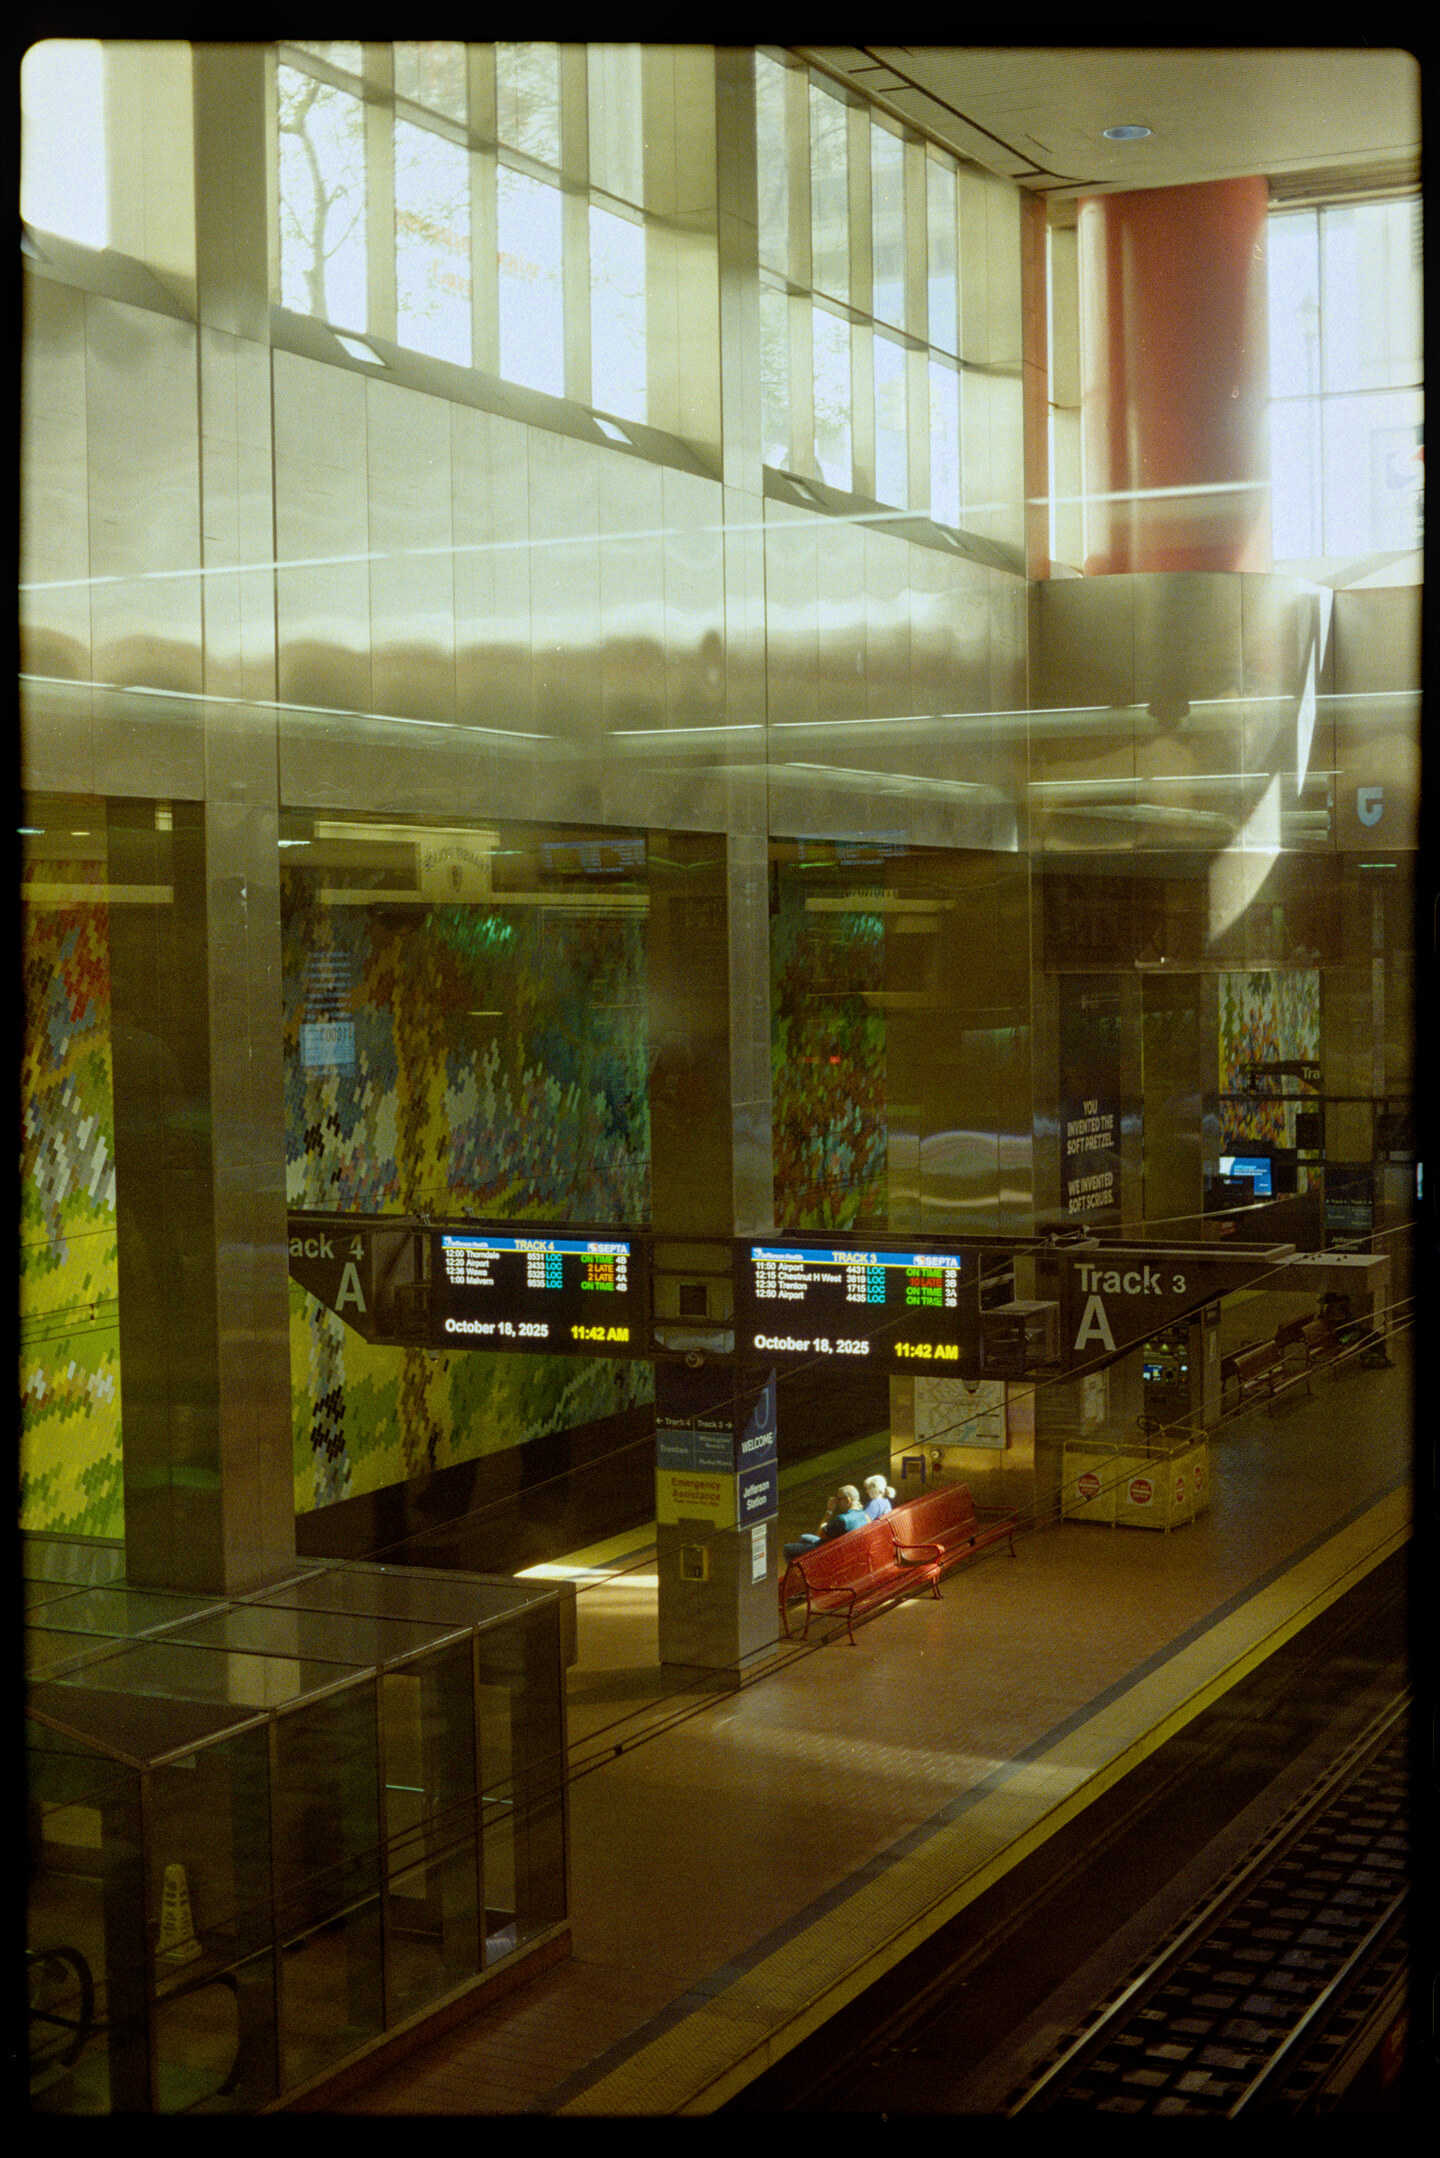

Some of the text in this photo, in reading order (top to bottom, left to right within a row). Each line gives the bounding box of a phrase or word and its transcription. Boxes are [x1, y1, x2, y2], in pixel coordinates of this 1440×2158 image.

[1301, 1066, 1320, 1080] Tra
[1083, 1100, 1098, 1115] YOU
[1067, 1113, 1114, 1137] INVENTED THE
[1067, 1137, 1085, 1155] SOFT
[1068, 1171, 1114, 1197] WE INVENTED
[1068, 1195, 1086, 1214] SOFT
[289, 1232, 365, 1261] ack 4
[514, 1240, 554, 1251] TRACK 4
[598, 1244, 628, 1253] SEPTA
[446, 1250, 464, 1258] 12:00
[466, 1250, 500, 1260] Thorndale
[545, 1253, 563, 1262] LOC
[580, 1254, 593, 1263] ON
[594, 1255, 614, 1264] TIME
[615, 1256, 628, 1265] 4B
[446, 1258, 464, 1267] 12:20
[466, 1259, 490, 1269] Airport
[545, 1262, 563, 1271] LOC
[594, 1264, 614, 1273] LATE
[615, 1265, 628, 1273] 4B
[832, 1252, 877, 1264] TRACK 3
[925, 1256, 958, 1267] SEPTA
[545, 1271, 563, 1280] LOC
[594, 1273, 614, 1282] LATE
[615, 1274, 628, 1282] 4A
[755, 1261, 957, 1278] 11:50 Airport 4431 LOC ON TIME 3B
[335, 1262, 367, 1312] A
[450, 1276, 464, 1284] 1:00
[466, 1276, 494, 1285] Malvern
[545, 1280, 563, 1289] LOC
[580, 1281, 593, 1290] ON
[594, 1282, 614, 1291] TIME
[615, 1283, 628, 1292] 4B
[755, 1270, 957, 1288] 12:15 Chestnut H West 3819 LOC 10 LATE 3B
[1074, 1263, 1187, 1295] Track 3
[755, 1280, 957, 1297] 12:30 Trenton 1715 LOC ON TIME 3A
[755, 1289, 957, 1307] 12:50 Airport 4435 LOC ON TIME 3B
[446, 1319, 549, 1338] October 18, 2025
[1074, 1295, 1117, 1350] A
[571, 1325, 629, 1342] 11:42 AM
[754, 1334, 870, 1355] October 18, 2025
[894, 1342, 959, 1360] 11:42 AM
[665, 1417, 685, 1426] Track
[697, 1419, 717, 1428] Track
[741, 1431, 774, 1454] WELCOME
[671, 1477, 721, 1491] Emergency
[743, 1481, 770, 1499] Jefferson
[672, 1489, 721, 1501] Assistance
[746, 1495, 767, 1511] Station
